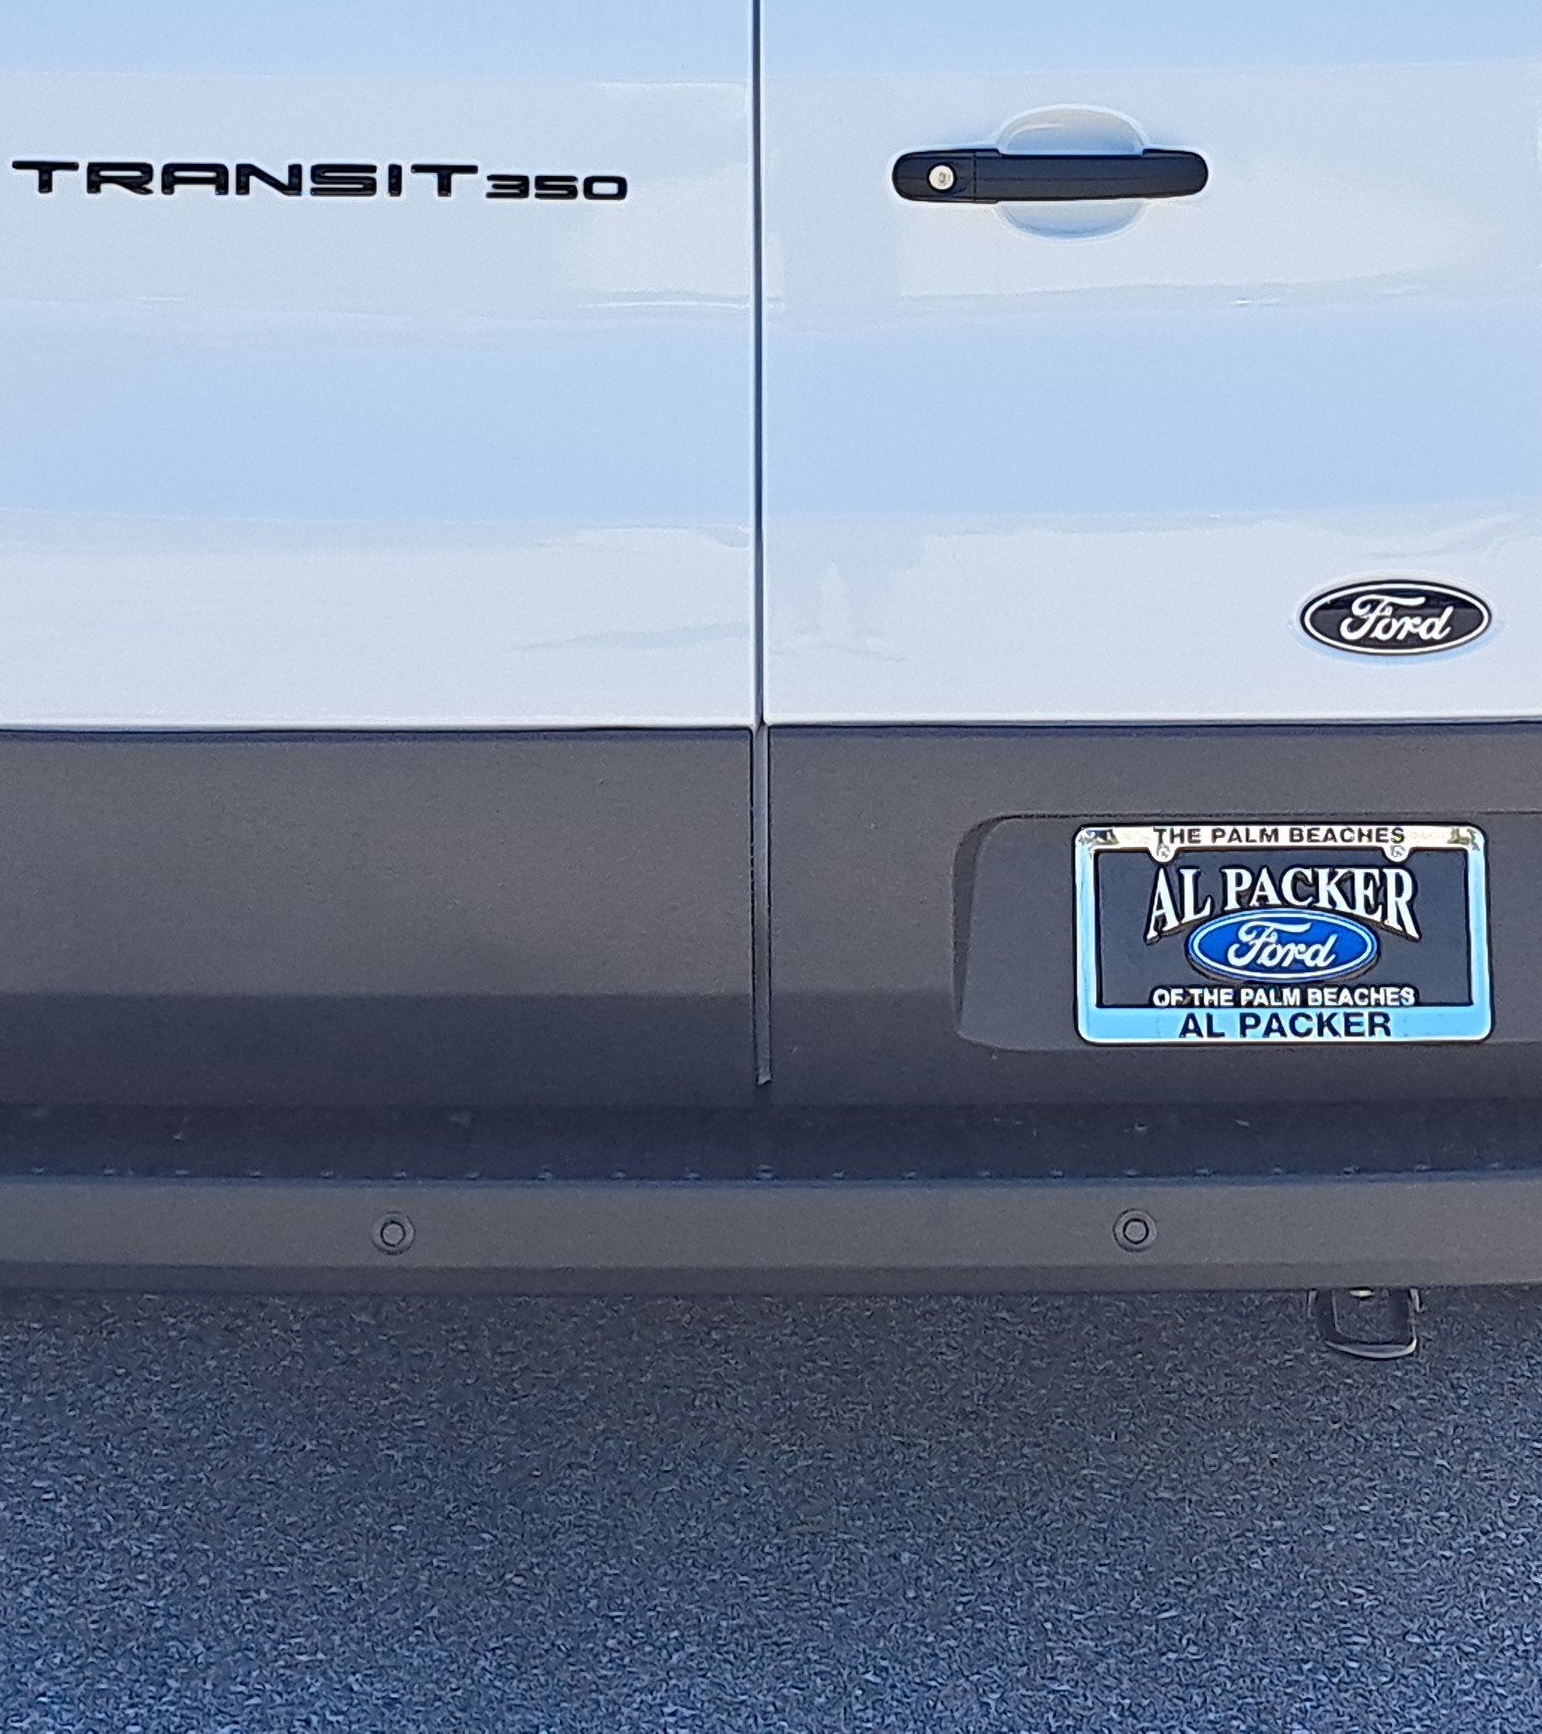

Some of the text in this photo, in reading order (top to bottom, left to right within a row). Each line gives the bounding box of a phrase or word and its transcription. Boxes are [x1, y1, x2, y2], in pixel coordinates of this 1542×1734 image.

[11, 160, 629, 201] TRANSIT 350
[1340, 594, 1454, 641] Ford
[1154, 827, 1406, 845] THE PALM BEACHES
[1145, 866, 1421, 943] AL PACKER
[1227, 921, 1340, 968] Ford
[1152, 987, 1416, 1008] OF THE PALM BEACHES
[1178, 1012, 1392, 1039] AL PACKER
